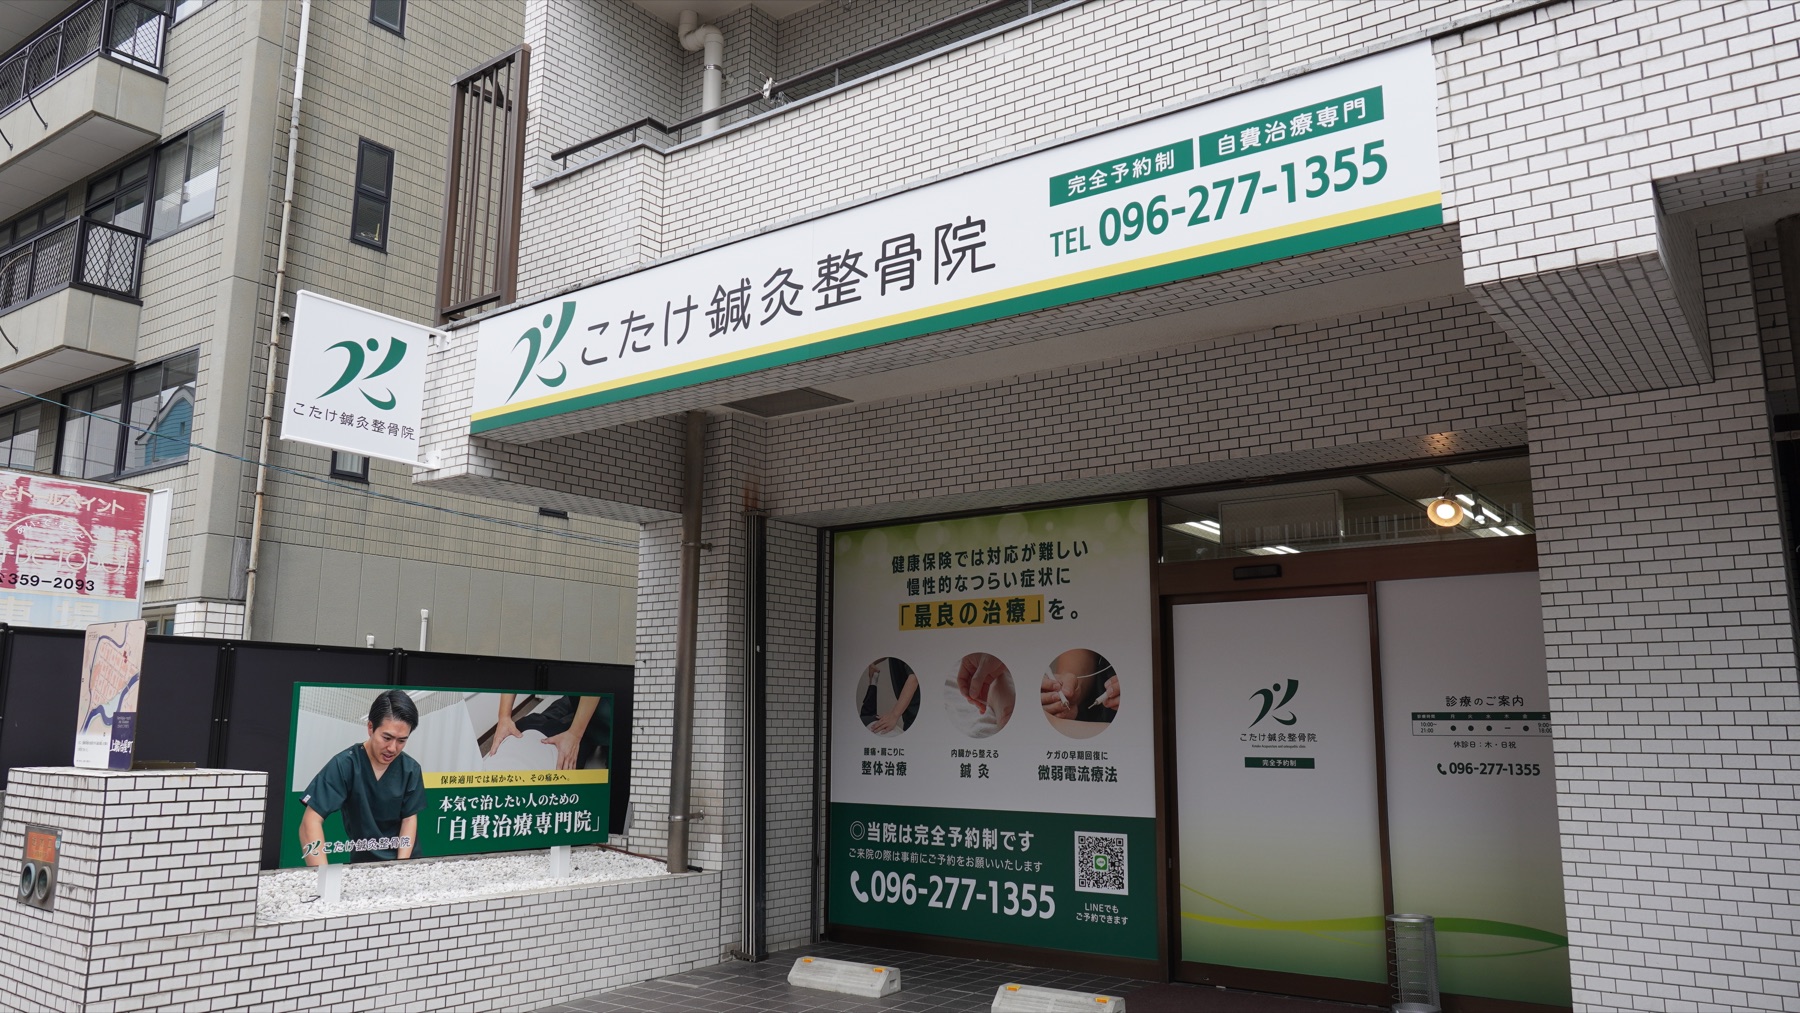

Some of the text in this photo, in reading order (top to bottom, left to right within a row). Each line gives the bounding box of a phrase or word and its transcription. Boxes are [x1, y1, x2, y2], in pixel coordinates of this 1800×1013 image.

[1218, 97, 1366, 156] 自費治療専門
[1068, 150, 1175, 196] 完全予約制
[1050, 139, 1388, 257] TEL 096-277-1355
[580, 215, 996, 366] こたけ鍼灸整骨院
[293, 402, 415, 440] こたけ鍼灸整骨院
[892, 540, 1089, 574] 健康保険では対応が難しい
[8, 573, 95, 591] 359-2093
[906, 566, 1072, 596] 慢性的なつらい症状に
[900, 597, 1080, 628] 「最良の治療」を。
[1445, 695, 1524, 707] 診療のご案内
[1239, 732, 1318, 742] こたけ鍼灸整骨院
[950, 749, 999, 759] 内臓から整える
[1046, 750, 1108, 761] ケガの早期回復に
[1262, 759, 1297, 767] 完全予約制
[861, 760, 907, 776] 整体治療
[960, 763, 990, 779] 鍼灸
[1038, 764, 1118, 783] 微弱電流療法
[1449, 762, 1540, 776] 096-277-1355
[440, 772, 570, 785] 保険適用では届かない、その痛みへ。
[439, 793, 580, 812] 本気で治したい人のための
[437, 809, 600, 841] 「自費治療専門院」
[322, 836, 411, 853] こたけ鍼灸整骨院
[848, 848, 1043, 873] ご来院の際は事前にご予約をお願いいたします
[871, 871, 1056, 919] 096-277-1355
[1084, 902, 1119, 914] LINEでも
[1075, 913, 1129, 926] ご予約できます
